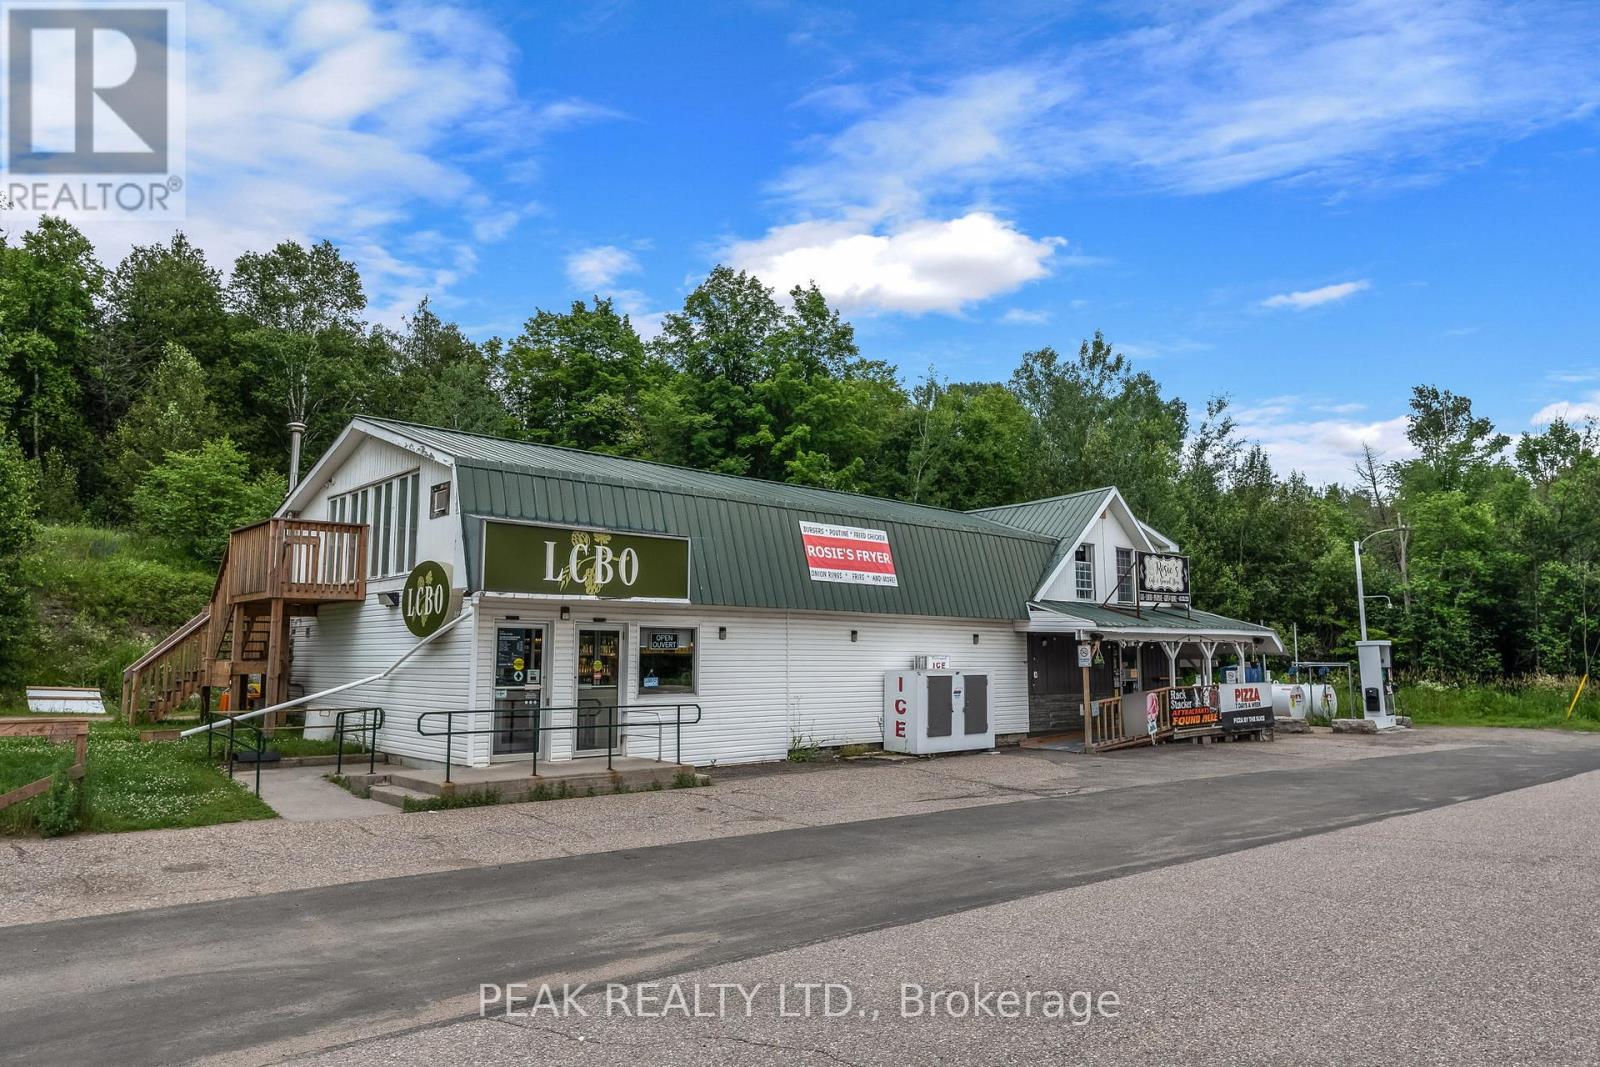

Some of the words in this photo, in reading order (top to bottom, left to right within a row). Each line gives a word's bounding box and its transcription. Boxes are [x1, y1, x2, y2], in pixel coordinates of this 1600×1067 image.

[829, 529, 848, 537] POUTINE
[807, 545, 854, 560] ROSIE'S
[856, 549, 890, 564] FRYER
[543, 541, 639, 586] LCBO
[811, 570, 827, 578] ONION
[828, 571, 842, 579] RINGS
[407, 584, 444, 617] LCBO
[1234, 688, 1260, 702] PIZZA
[894, 677, 907, 738] ICE
[1172, 715, 1201, 725] FOUND
